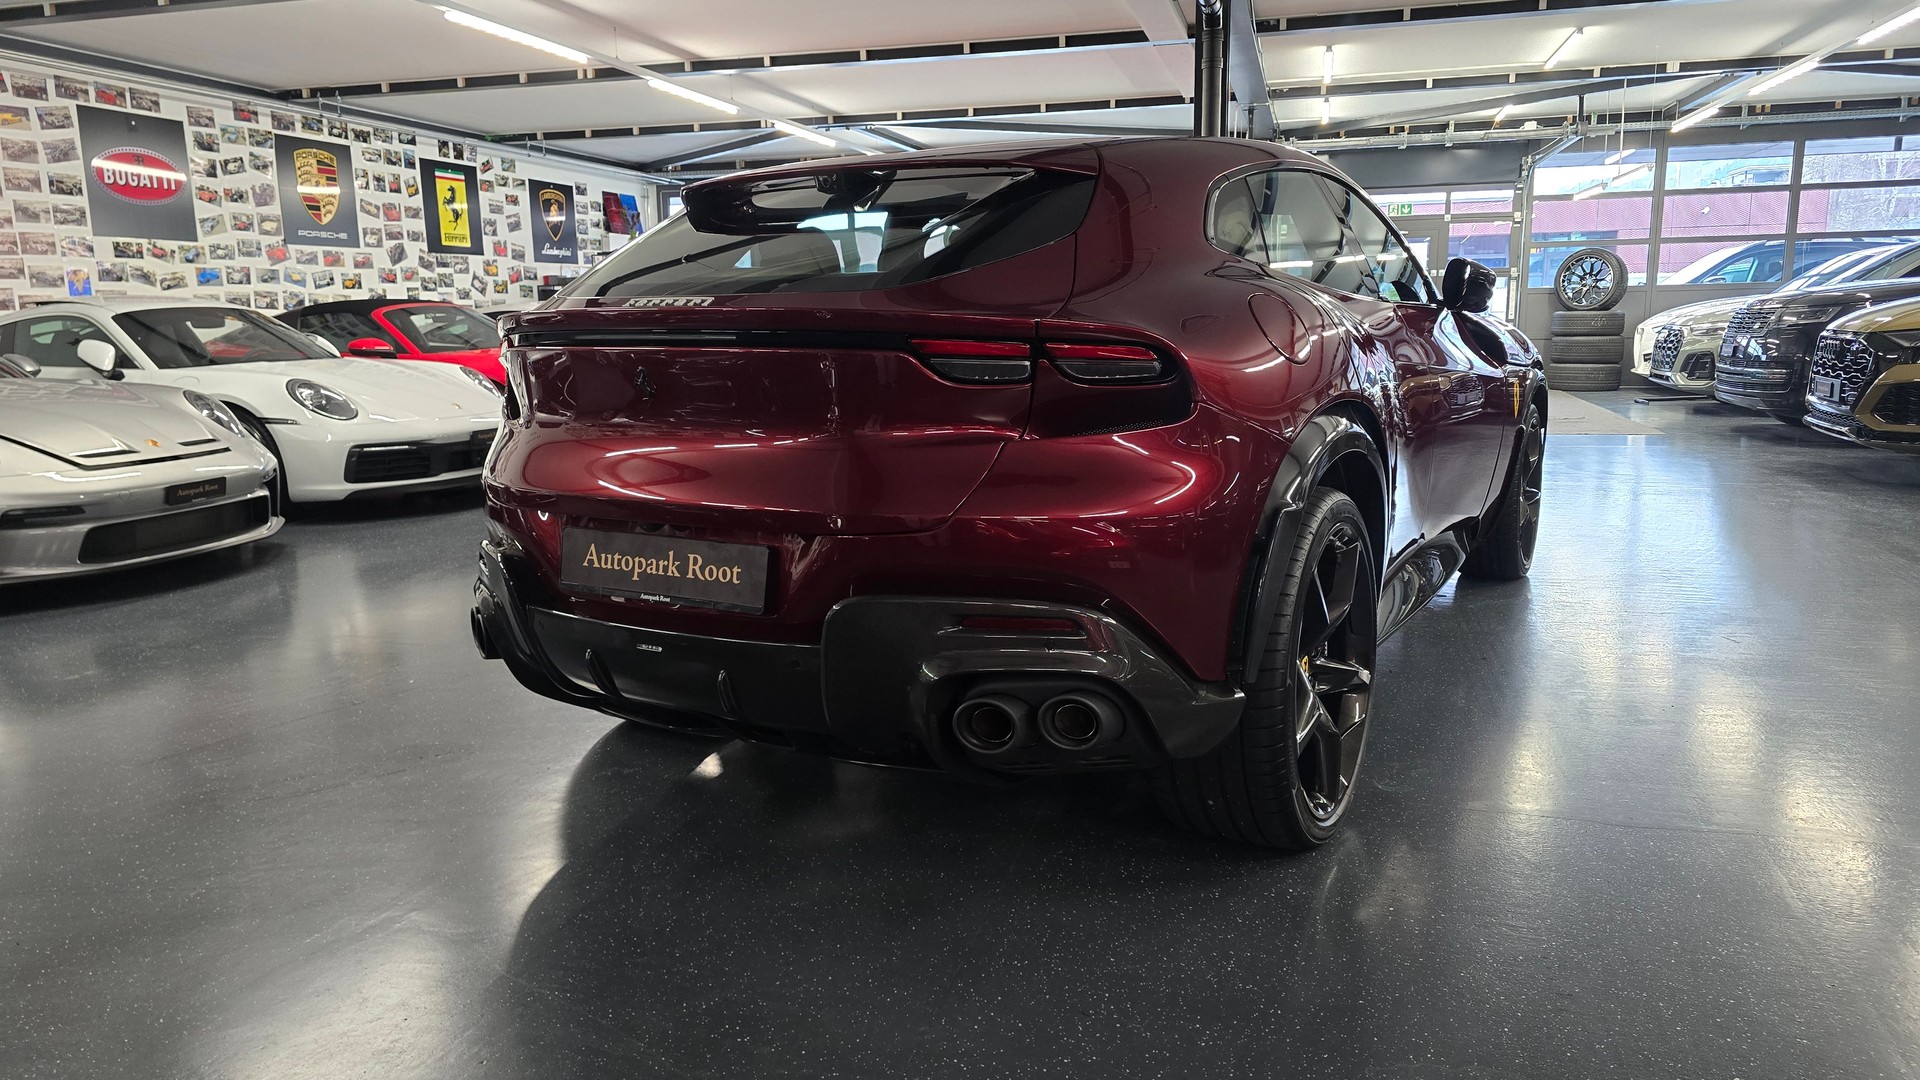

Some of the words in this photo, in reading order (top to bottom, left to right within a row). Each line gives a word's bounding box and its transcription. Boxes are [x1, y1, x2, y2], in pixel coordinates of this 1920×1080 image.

[295, 150, 335, 165] PORSCHE
[103, 165, 176, 191] BUGATTI
[298, 229, 348, 240] PORSCHE
[541, 242, 573, 258] Lamborghini
[582, 543, 681, 581] Autopark
[686, 553, 742, 585] Root
